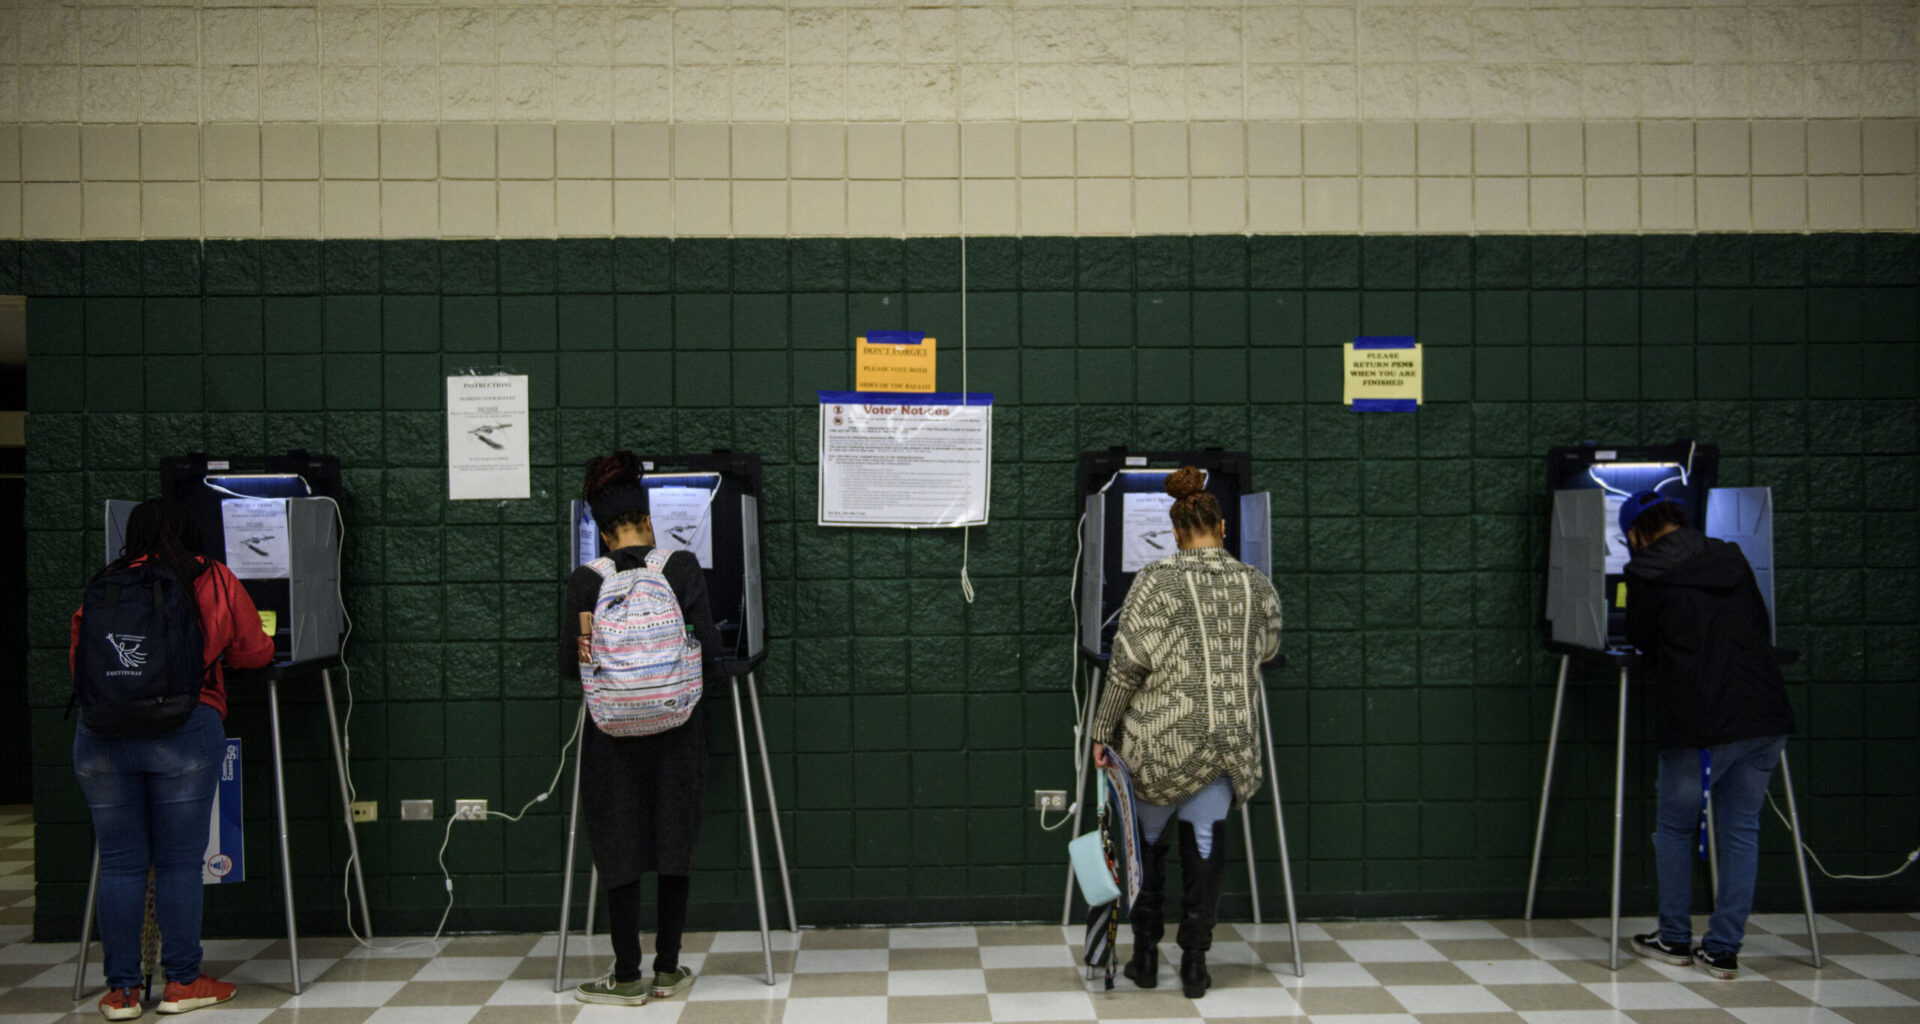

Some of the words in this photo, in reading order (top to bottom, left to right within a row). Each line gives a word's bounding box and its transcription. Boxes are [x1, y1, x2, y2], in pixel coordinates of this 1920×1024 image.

[892, 348, 927, 357] FORGET
[1366, 352, 1400, 360] PLEASE
[1353, 361, 1390, 369] RETURN
[1362, 379, 1404, 387] FINISHED
[863, 404, 897, 415] Voter
